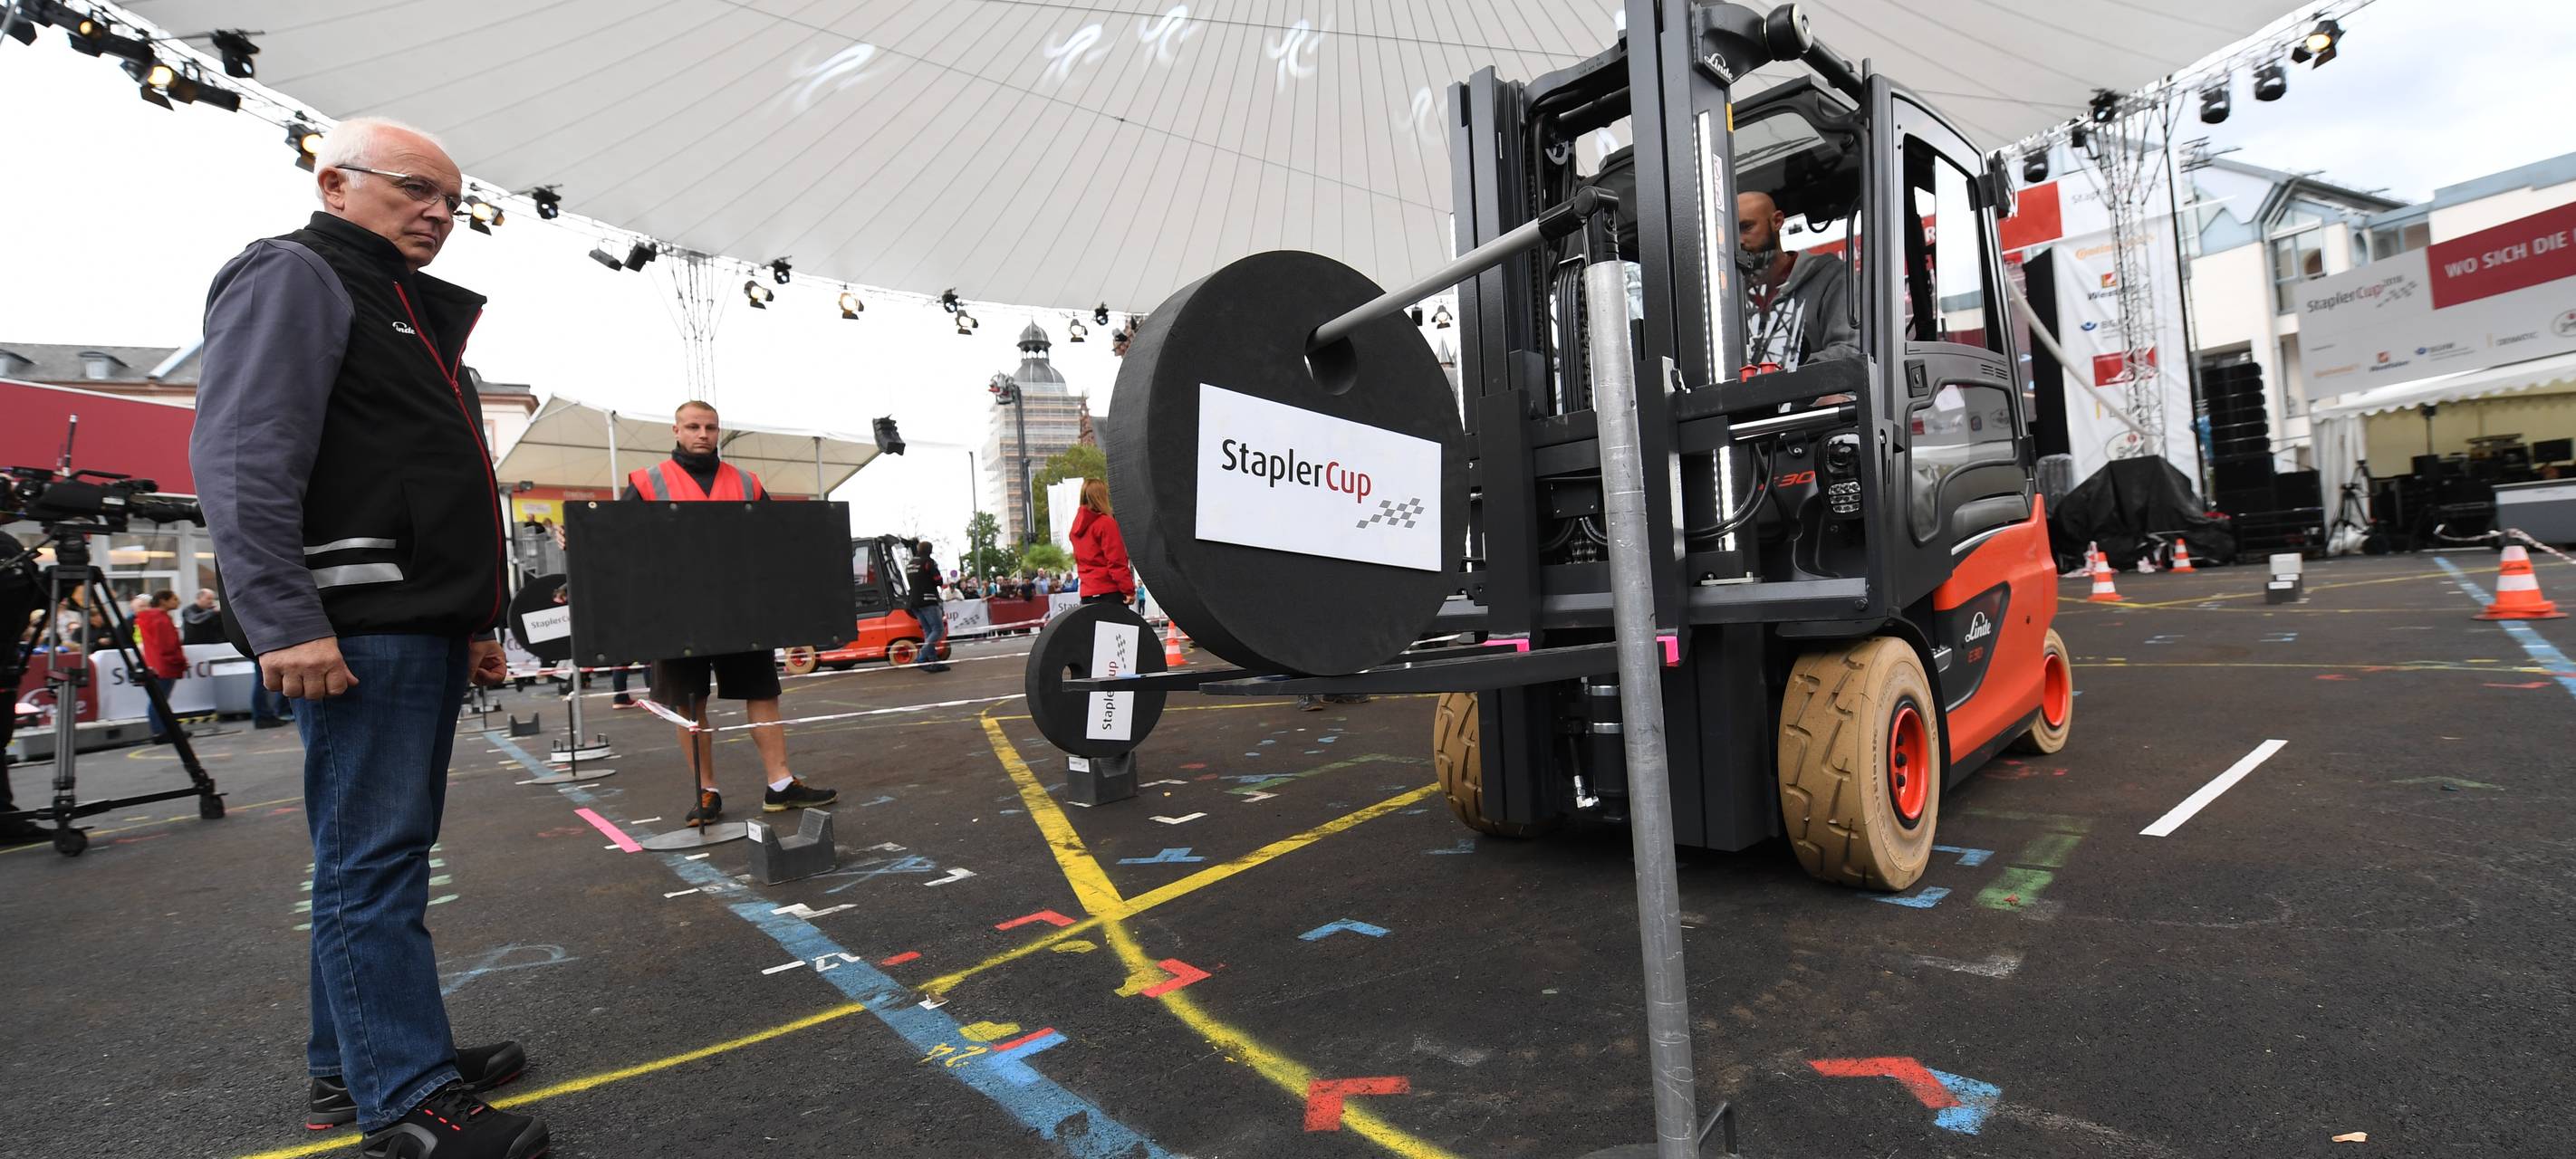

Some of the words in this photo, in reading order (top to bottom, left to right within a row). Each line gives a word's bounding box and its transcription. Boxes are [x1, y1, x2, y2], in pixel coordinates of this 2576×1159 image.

[1704, 53, 1734, 81] Linde
[2445, 257, 2478, 278] WO
[2482, 243, 2528, 269] SICH
[2533, 231, 2569, 254] DIE
[2306, 283, 2384, 313] StaplerCup
[1222, 438, 1371, 503] StaplerCup
[531, 615, 571, 629] StaplerC
[1965, 611, 1992, 643] Linde
[1967, 647, 1984, 663] E30
[1102, 661, 1119, 731] Stapleup
